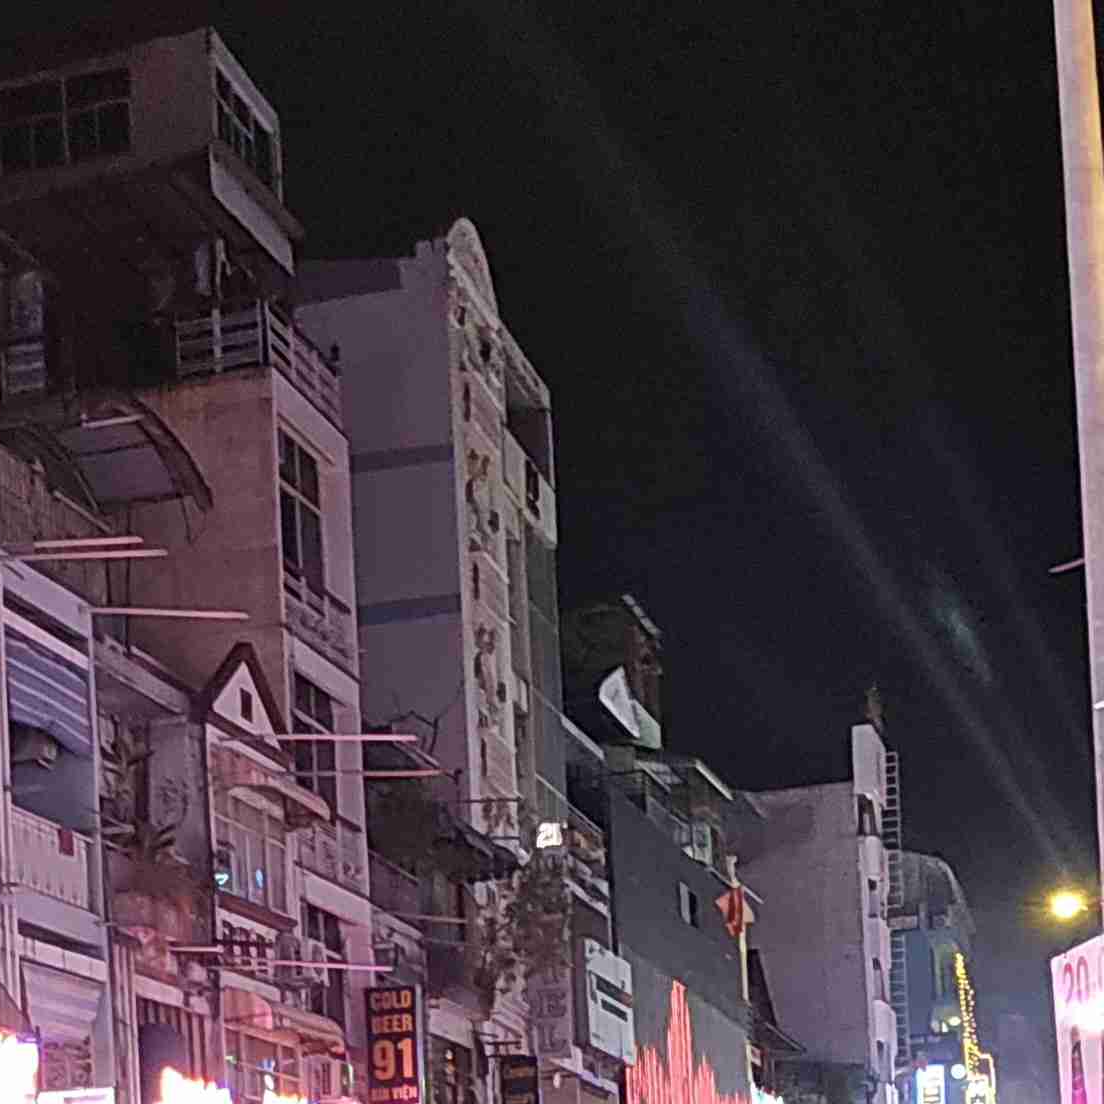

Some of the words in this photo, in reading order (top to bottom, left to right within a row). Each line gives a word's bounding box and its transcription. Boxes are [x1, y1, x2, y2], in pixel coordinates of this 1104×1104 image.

[370, 990, 413, 1011] COLD
[371, 1013, 413, 1034] BEER
[373, 1038, 415, 1081] 91
